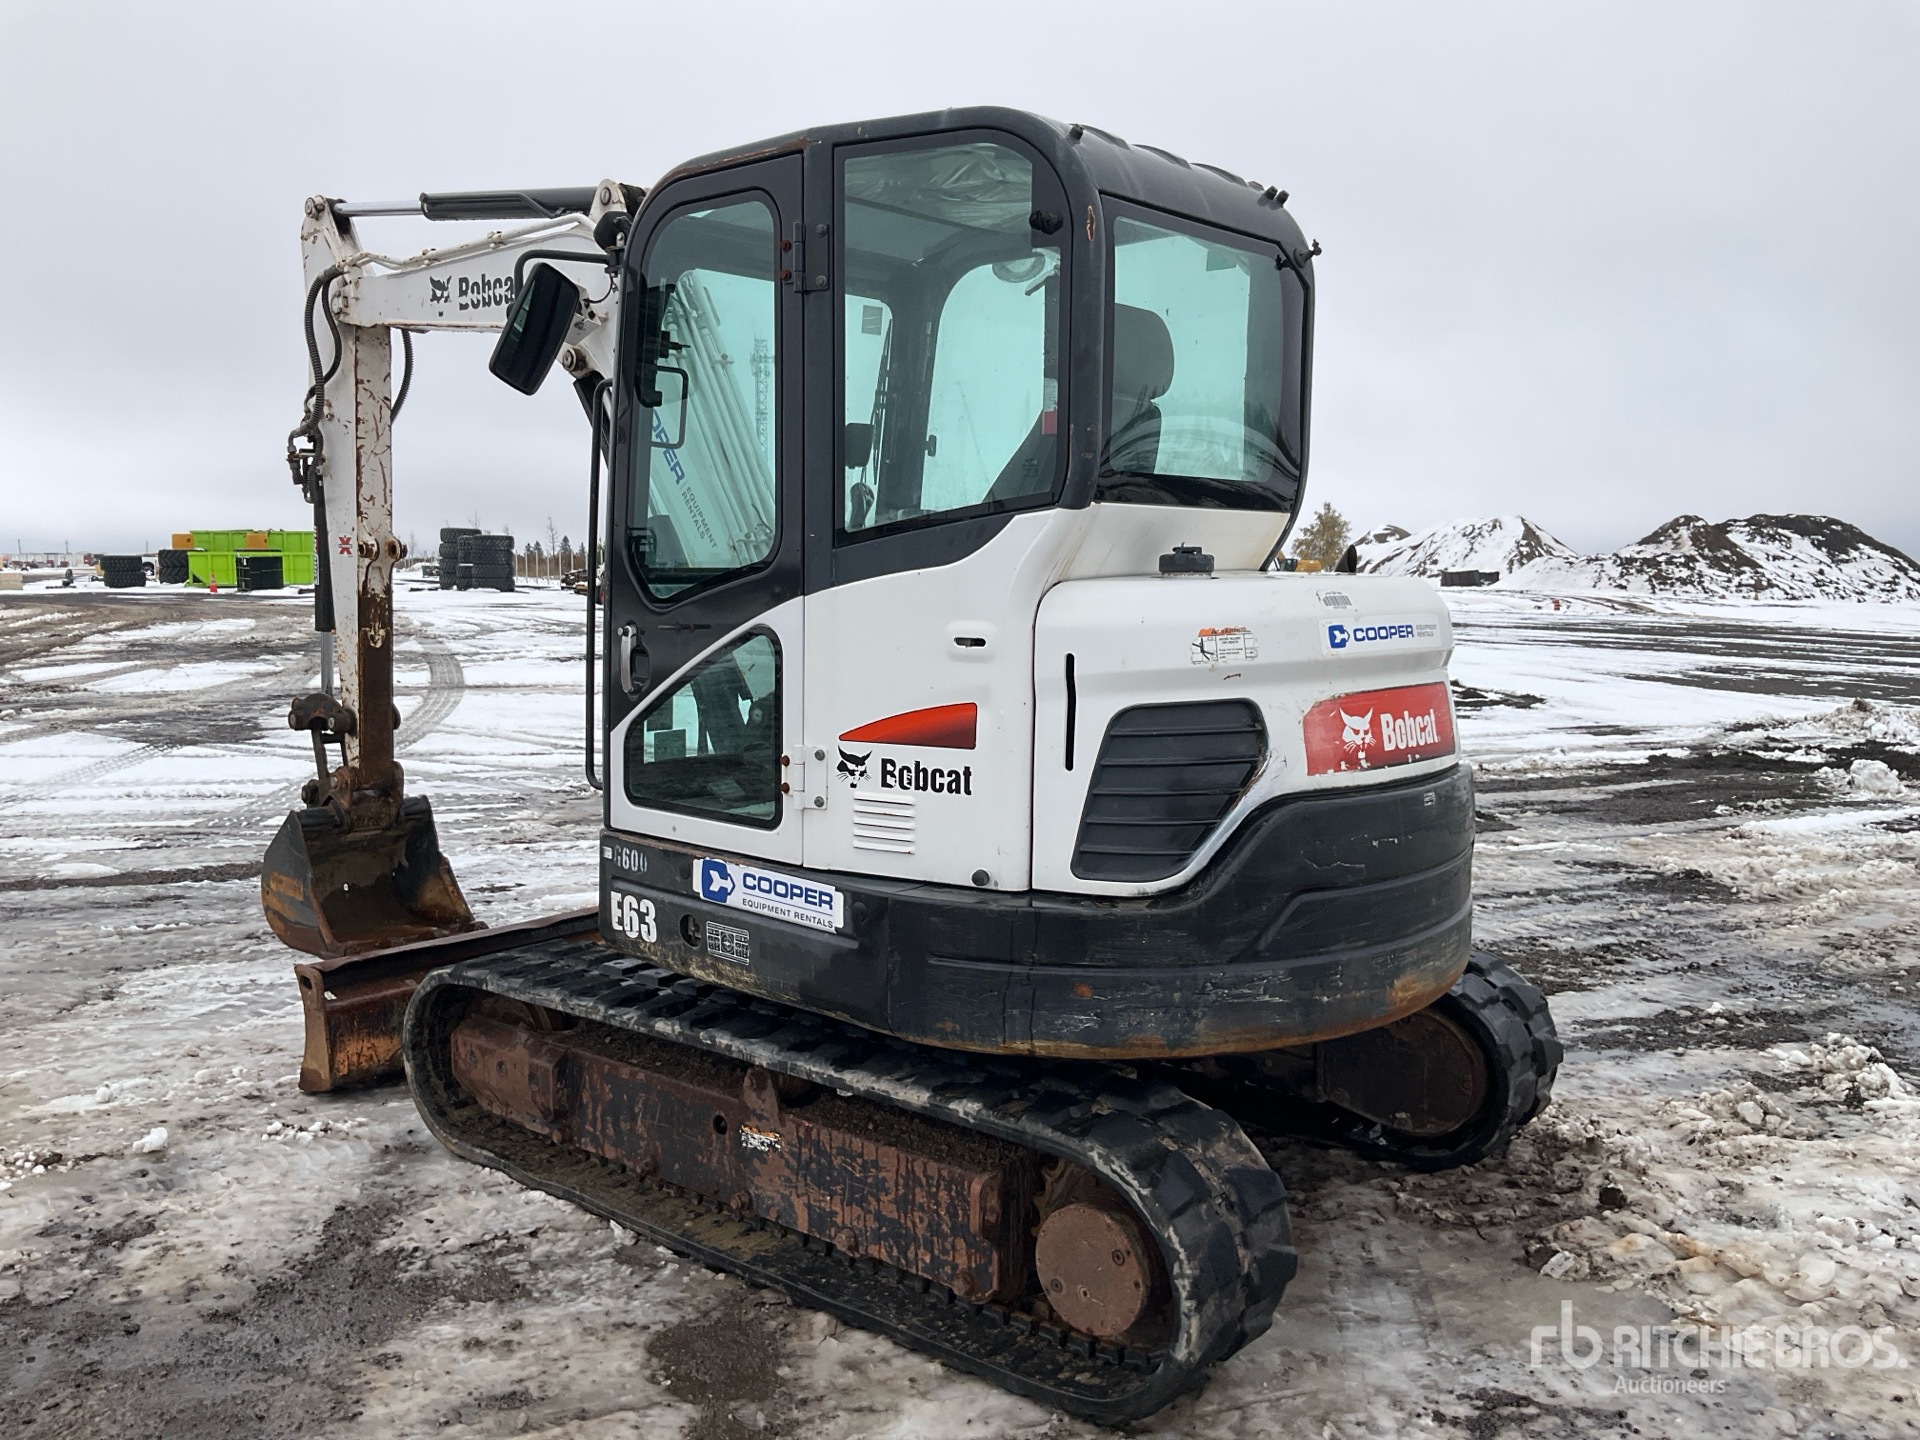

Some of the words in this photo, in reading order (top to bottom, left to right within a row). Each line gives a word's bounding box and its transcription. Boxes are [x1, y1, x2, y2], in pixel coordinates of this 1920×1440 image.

[458, 274, 515, 311] Bobca
[681, 491, 707, 541] RENTALS
[686, 486, 718, 549] EQUIPMENT
[1352, 624, 1414, 643] COOPER
[1380, 709, 1438, 751] Bobcat
[880, 757, 972, 796] Bobcat
[742, 871, 834, 911] COOPER
[610, 890, 657, 943] E63
[741, 897, 791, 919] EQUIPMENT
[793, 911, 834, 929] RENTALS
